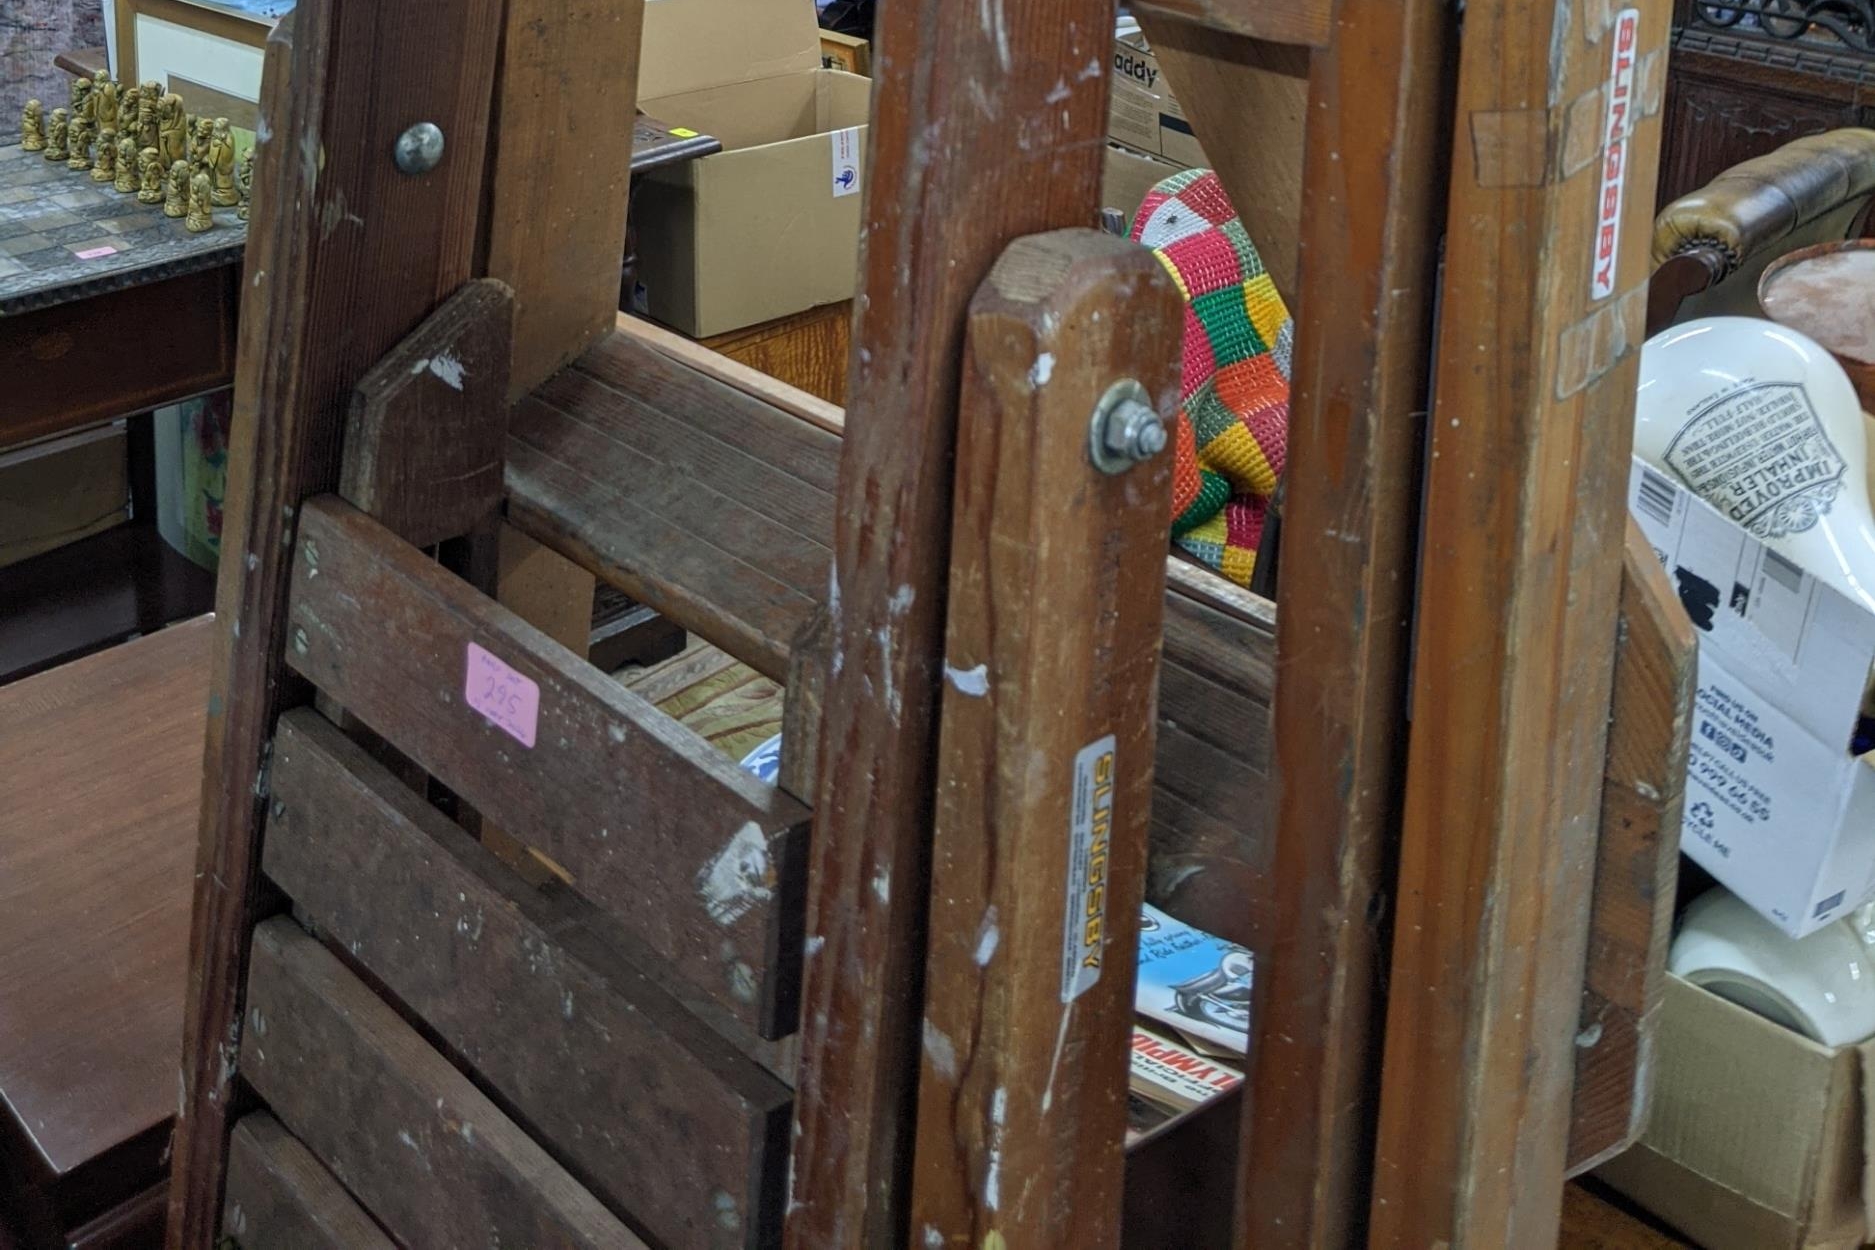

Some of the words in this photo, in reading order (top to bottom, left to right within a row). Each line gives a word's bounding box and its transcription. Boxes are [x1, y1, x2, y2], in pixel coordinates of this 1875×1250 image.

[1595, 16, 1636, 292] SLINGSBY
[1729, 444, 1810, 497] INHALER
[1729, 460, 1831, 522] IMPROVED
[483, 675, 523, 715] 295
[1733, 714, 1775, 749] MEDIA
[1082, 750, 1114, 969] SLINGSBY
